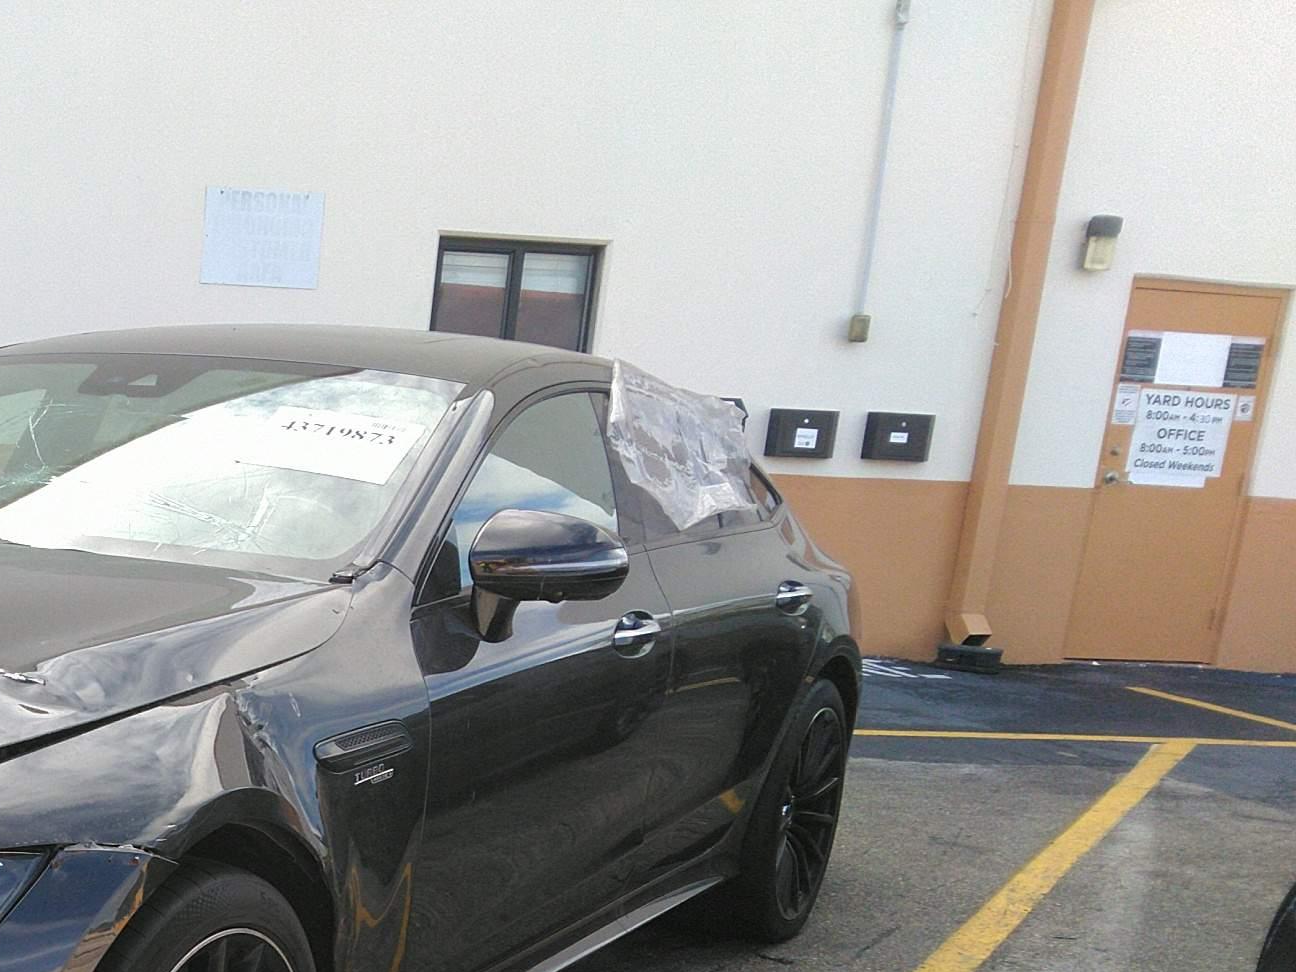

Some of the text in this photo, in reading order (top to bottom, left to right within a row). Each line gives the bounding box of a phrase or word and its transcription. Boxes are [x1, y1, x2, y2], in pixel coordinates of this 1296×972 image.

[1145, 393, 1182, 407] YARD
[1184, 396, 1232, 410] HOURS
[281, 420, 396, 445] 43719873
[1156, 427, 1206, 441] OFFICE
[1134, 458, 1216, 472] Closed Weekends
